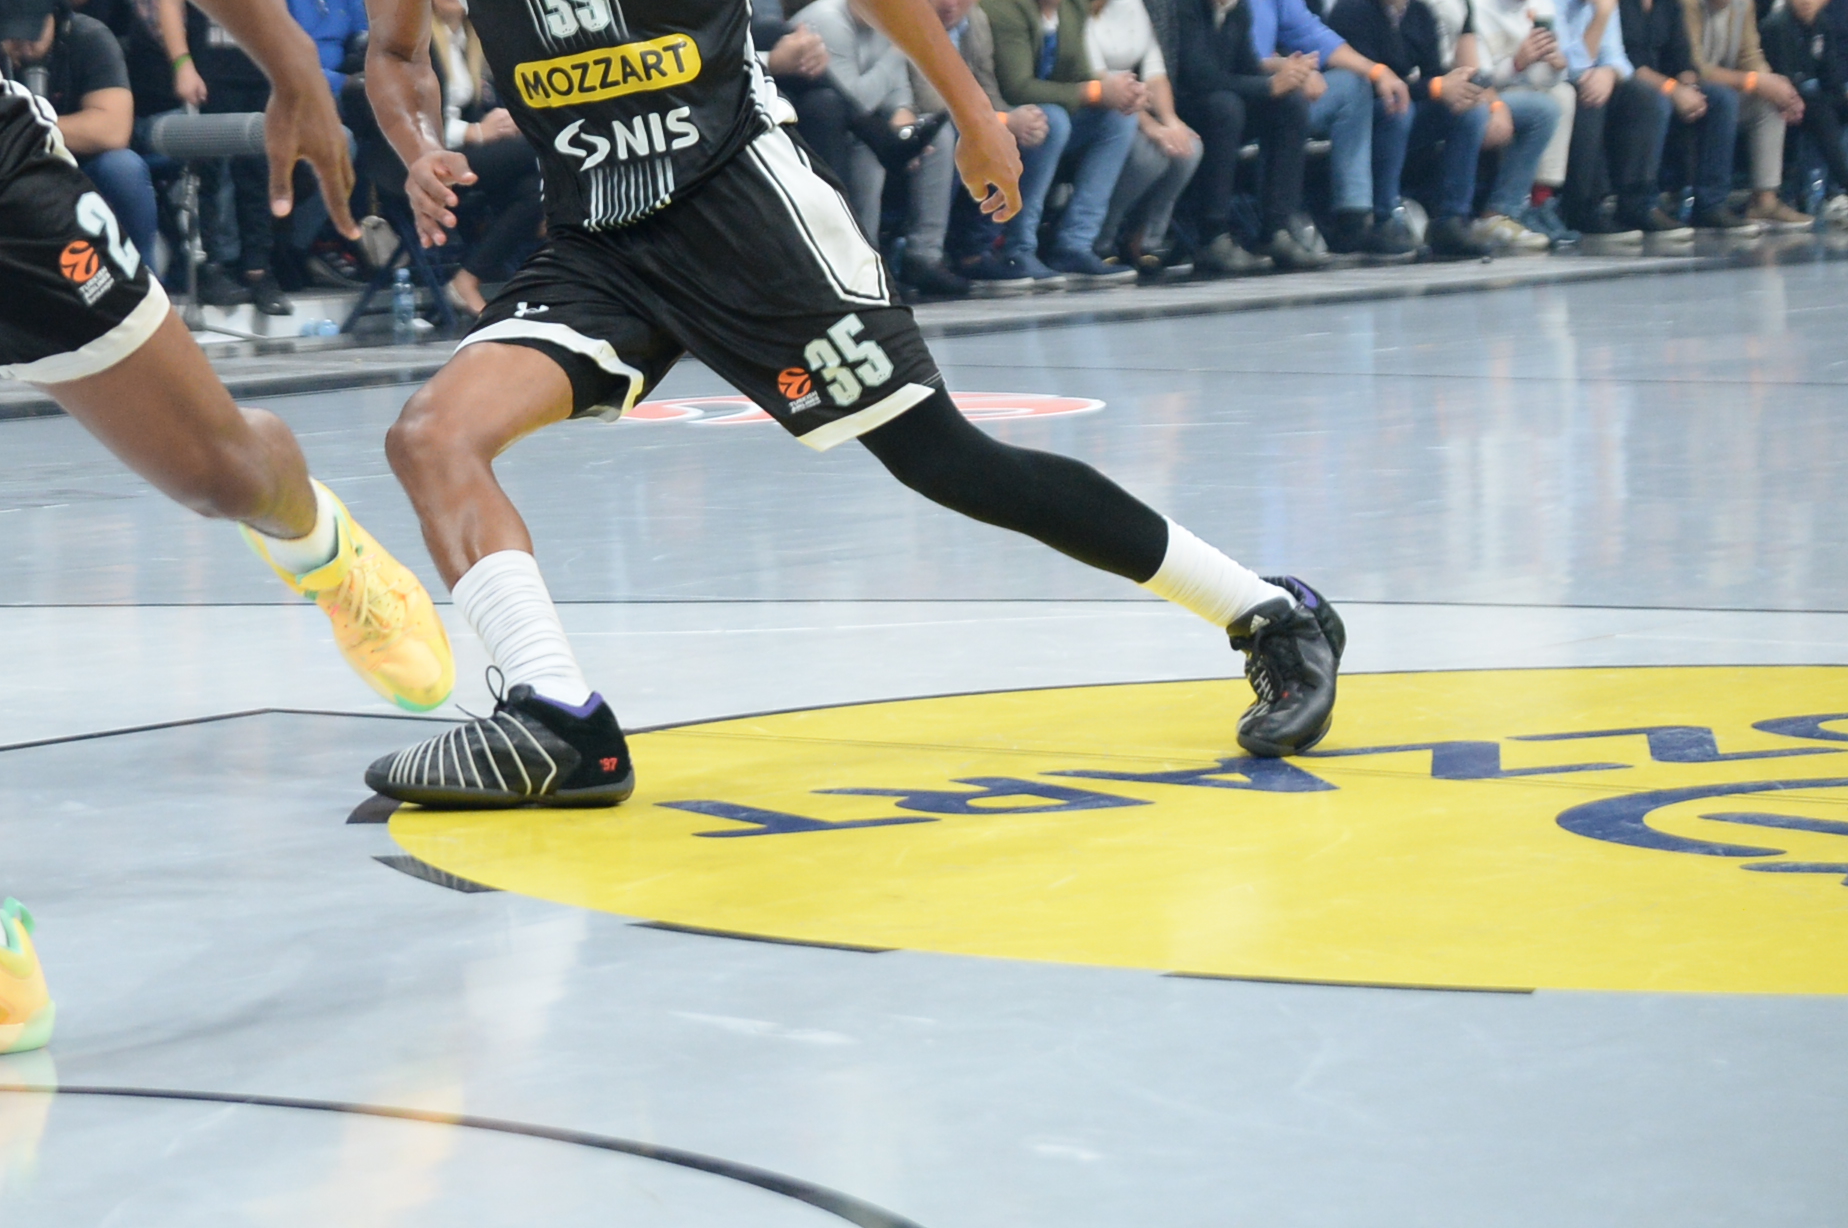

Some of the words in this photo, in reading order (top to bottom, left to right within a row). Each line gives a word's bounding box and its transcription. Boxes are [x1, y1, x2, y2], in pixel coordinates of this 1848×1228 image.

[520, 40, 688, 101] MOZZART
[611, 105, 700, 160] NIS
[75, 191, 141, 281] 2
[803, 312, 895, 407] 35
